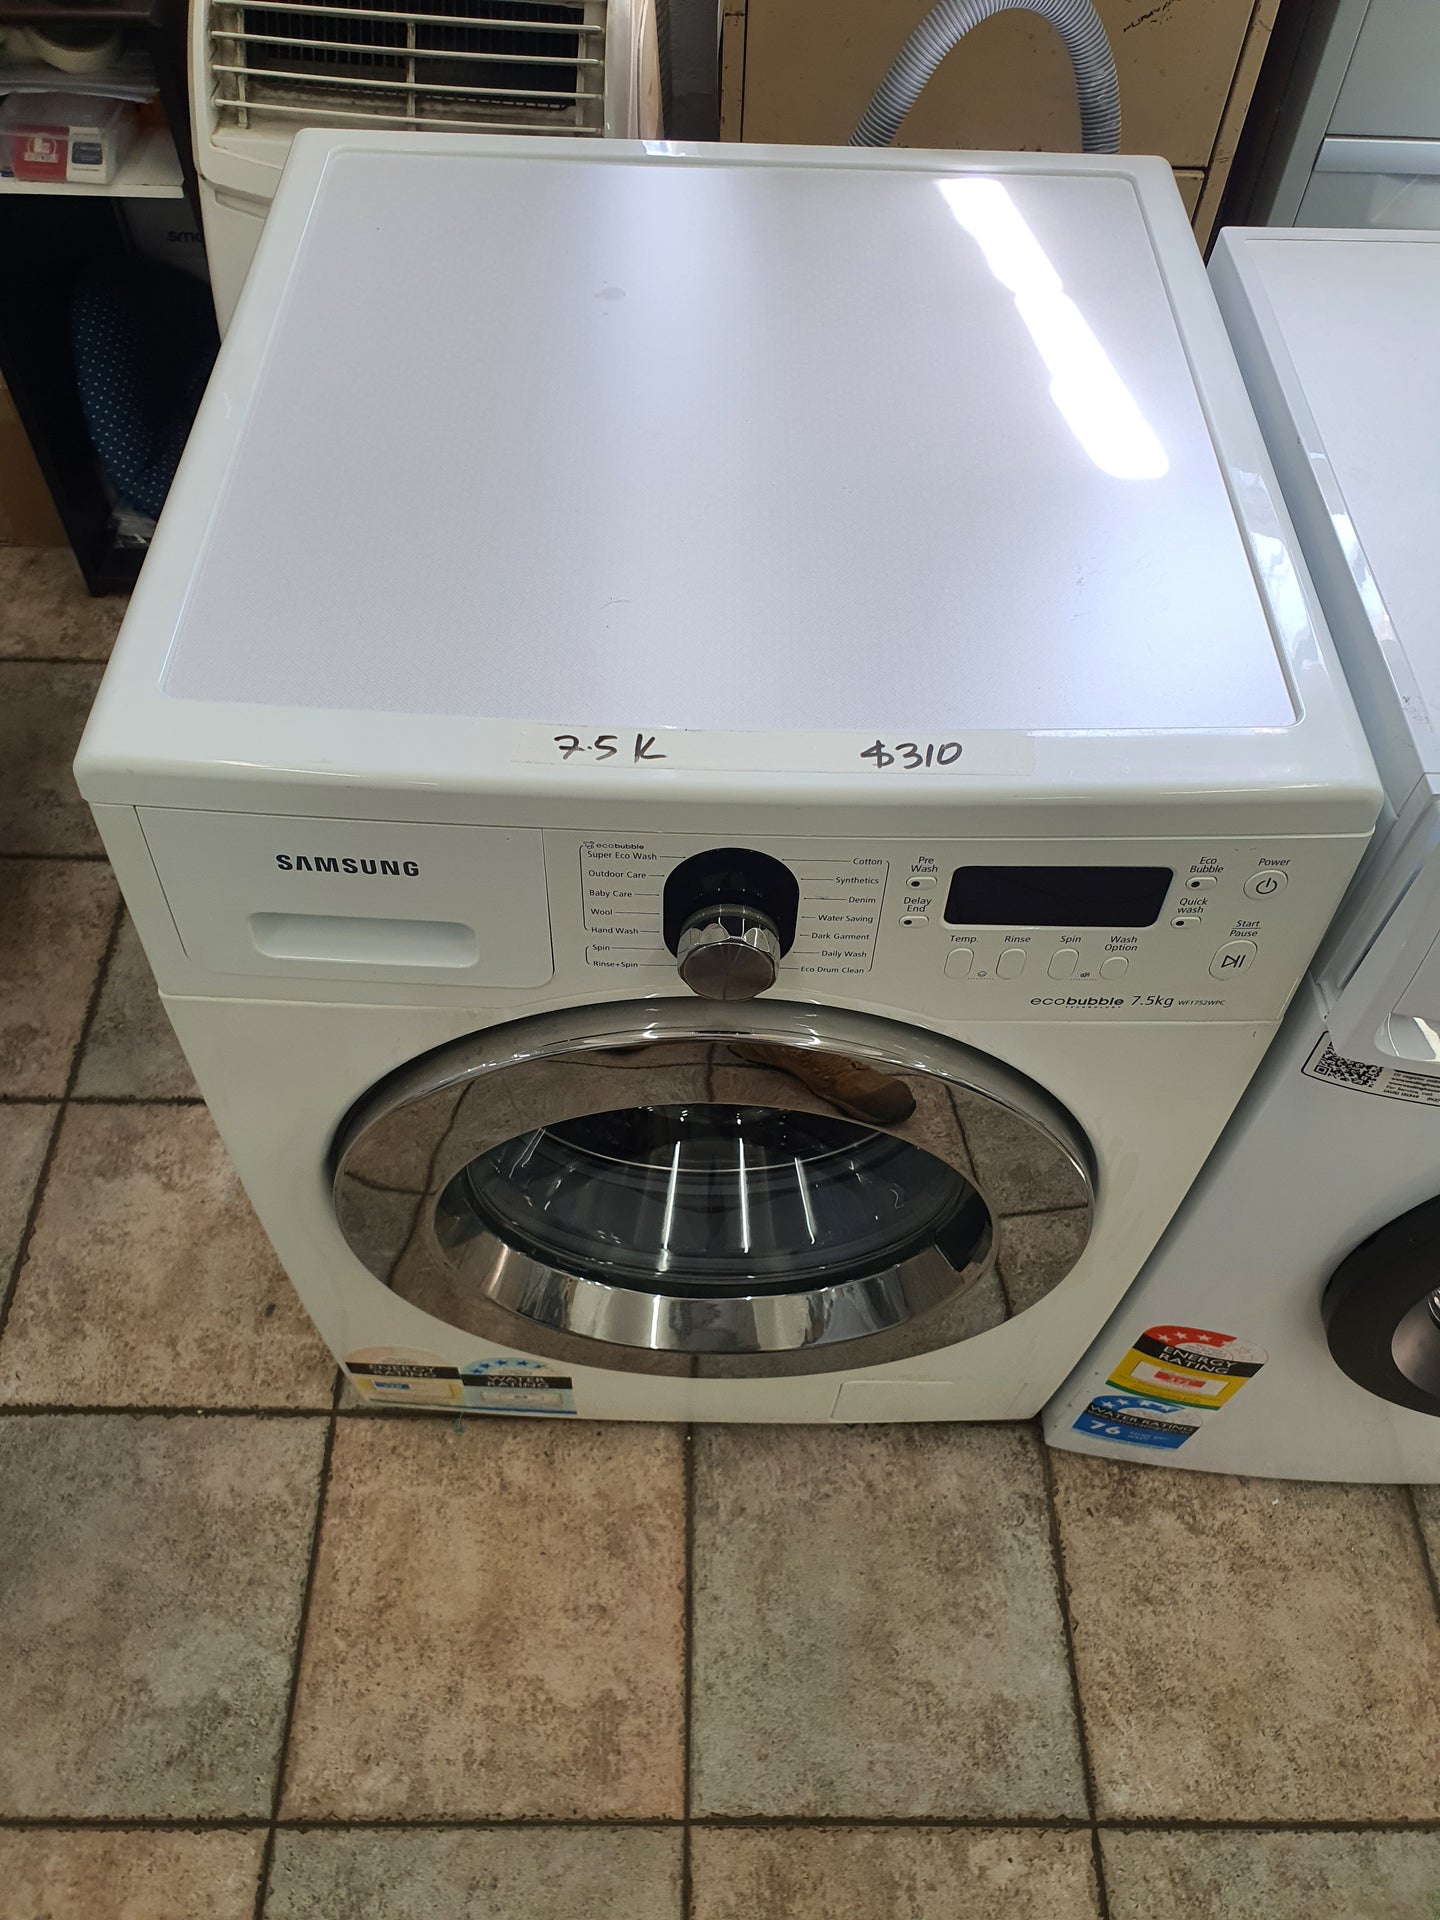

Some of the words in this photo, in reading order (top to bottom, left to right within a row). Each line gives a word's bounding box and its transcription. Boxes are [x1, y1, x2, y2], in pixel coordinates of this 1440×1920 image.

[554, 735, 618, 760] 7.5
[860, 739, 963, 769] $310
[596, 842, 645, 850] ecobubble
[587, 851, 612, 860] Super
[615, 852, 631, 860] Eco
[632, 852, 657, 860] Wash
[852, 857, 883, 866] Cotton
[918, 856, 935, 865] Pre
[1199, 856, 1218, 865] Eco
[1258, 858, 1291, 866] Power
[275, 854, 419, 877] SAMSUNG
[910, 864, 938, 873] Wash
[1189, 865, 1224, 874] Bubble
[588, 869, 624, 878] Outdoor
[626, 871, 647, 879] Care
[835, 876, 879, 885] Synthetics
[589, 889, 610, 898] Baby
[612, 890, 633, 898] Care
[848, 896, 876, 904] Denim
[903, 896, 932, 906] Delay
[1179, 898, 1208, 907] Quick
[590, 908, 613, 916] Wool
[906, 904, 926, 913] End
[1177, 906, 1204, 914] wash
[818, 914, 844, 922] Water
[845, 915, 873, 924] Saving
[1236, 920, 1260, 928] Start
[591, 926, 613, 934] Hand
[615, 927, 639, 935] Wash
[1229, 929, 1258, 937] Pause
[950, 935, 979, 944] Temp.
[1004, 935, 1031, 943] Rinse
[1060, 935, 1082, 944] Spin
[1110, 935, 1138, 944] Wash
[592, 944, 611, 952] Spin
[1104, 943, 1138, 952] Option
[821, 950, 842, 959] Daily
[593, 960, 638, 968] Rinse+Spin
[1030, 997, 1125, 1006] ecobubble
[1131, 995, 1174, 1008] 7.5kg
[1163, 1346, 1237, 1368] ENERGY
[1158, 1352, 1230, 1375] RATING
[1090, 1405, 1137, 1425] WATER
[1142, 1419, 1193, 1432] RATING
[1089, 1420, 1121, 1434] 76
